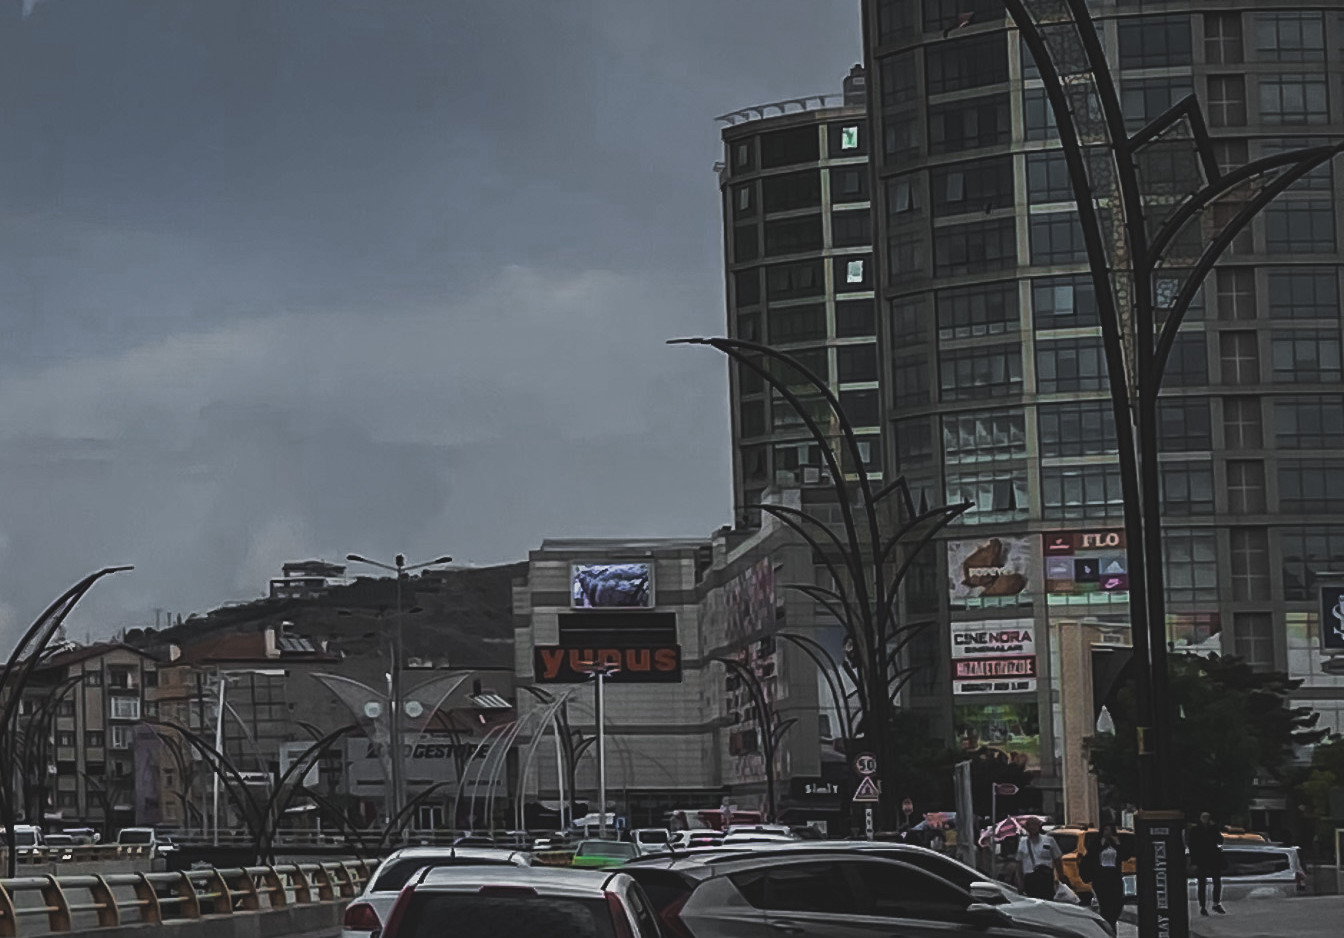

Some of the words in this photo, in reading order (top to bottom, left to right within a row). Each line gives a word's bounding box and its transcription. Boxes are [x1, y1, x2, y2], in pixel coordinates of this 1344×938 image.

[1081, 533, 1121, 548] FLO
[540, 648, 677, 679] yunus
[859, 758, 874, 772] 50
